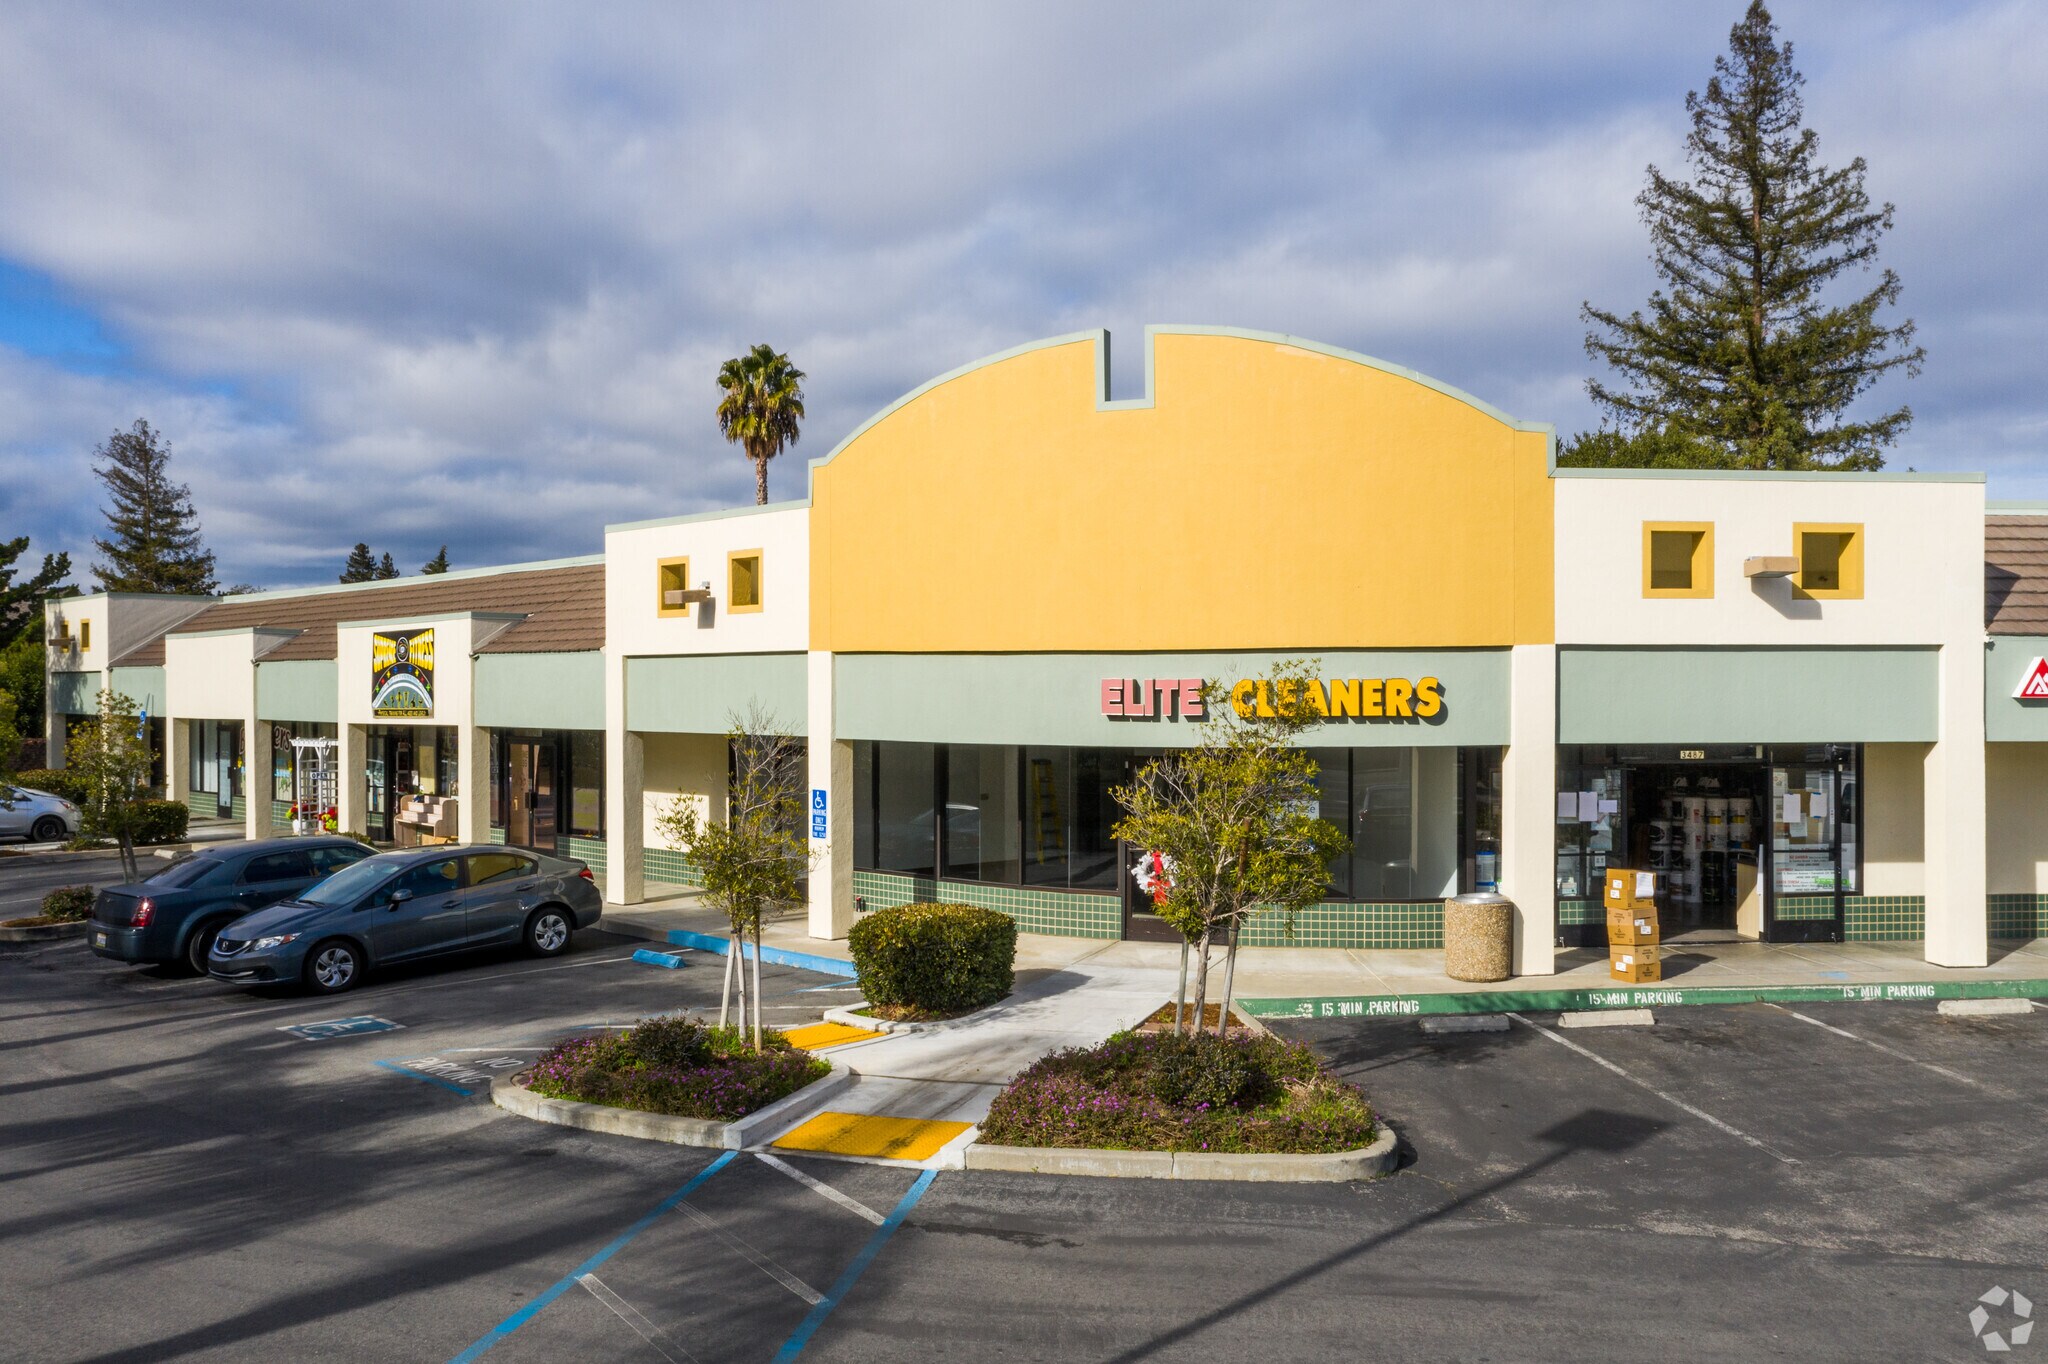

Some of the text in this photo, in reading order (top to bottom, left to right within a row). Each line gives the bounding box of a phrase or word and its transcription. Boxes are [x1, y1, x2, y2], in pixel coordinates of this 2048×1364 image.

[373, 634, 397, 672] SUPREME
[409, 629, 434, 671] FITNESS
[1101, 677, 1441, 718] ELITE CLEANERS
[1680, 751, 1704, 759] 3487
[1634, 991, 1683, 1005] PARKING
[1842, 985, 1935, 998] 15 MIN PARKING
[1367, 999, 1420, 1015] PARKING
[400, 1056, 494, 1084] PARKING
[474, 1056, 525, 1069] NO
